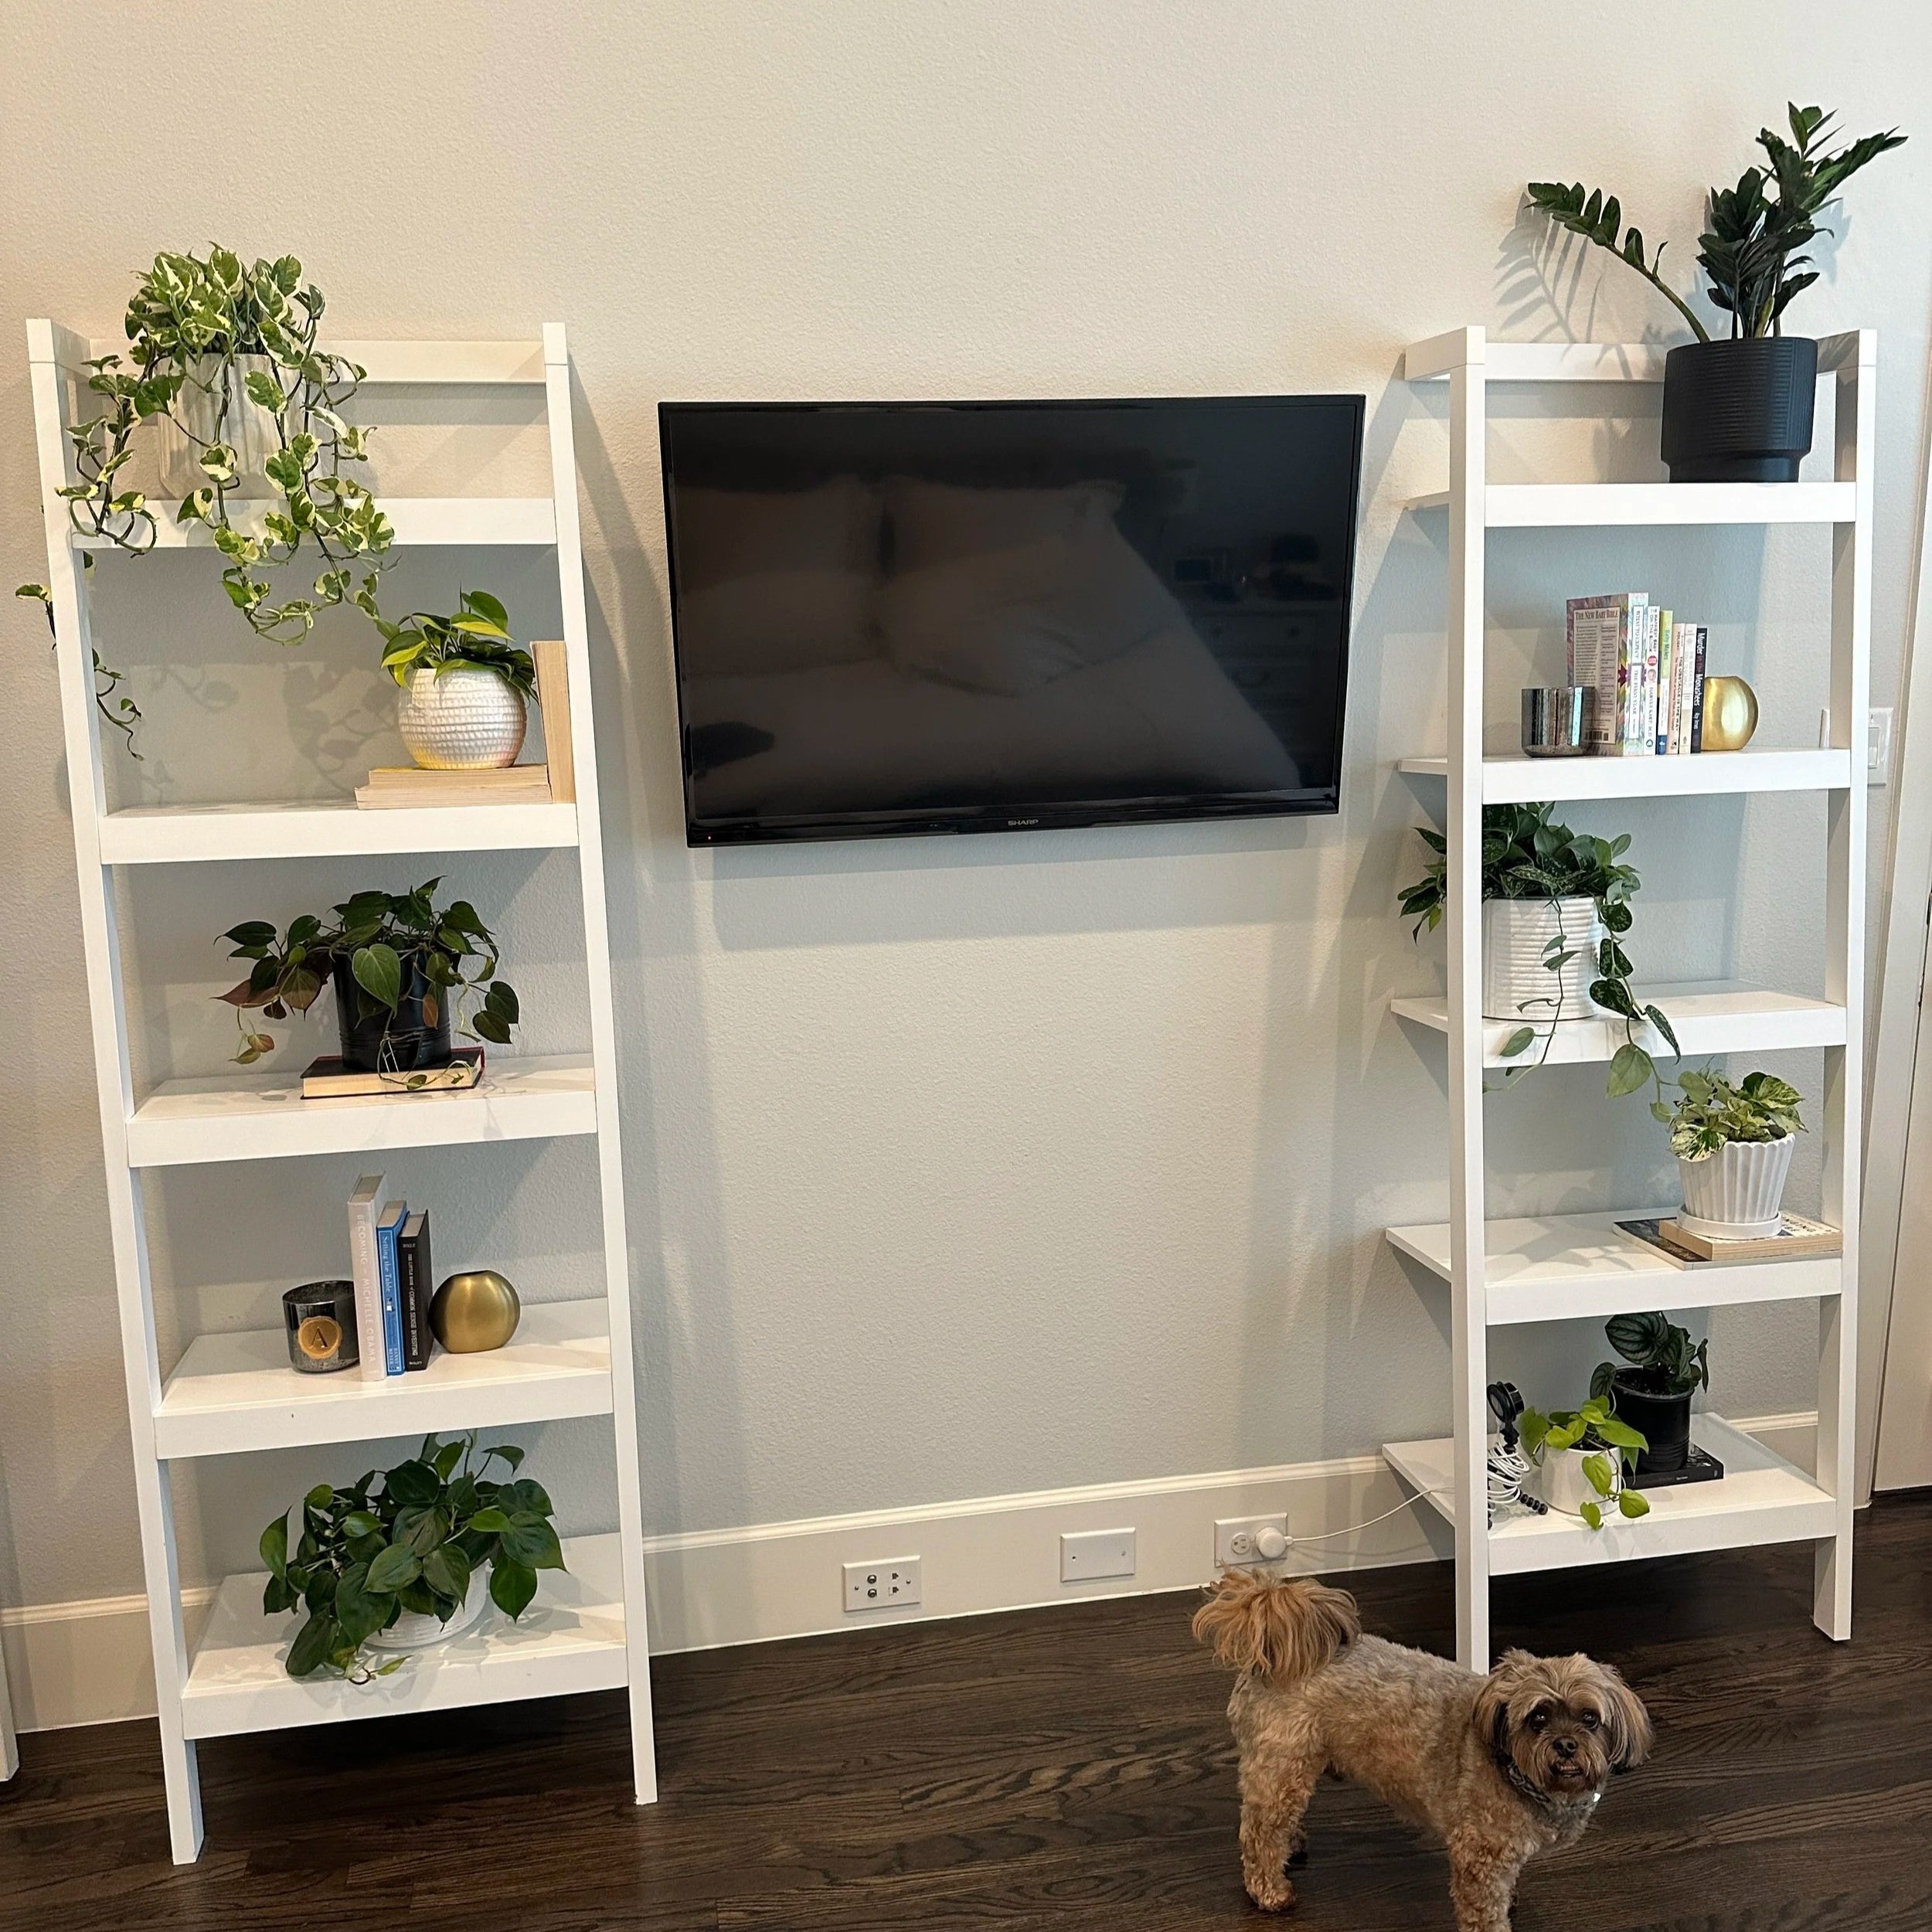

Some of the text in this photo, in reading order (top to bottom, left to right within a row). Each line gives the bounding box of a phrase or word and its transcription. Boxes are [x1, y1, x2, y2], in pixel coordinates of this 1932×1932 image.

[1585, 611, 1595, 619] NEW
[1607, 609, 1618, 617] BIBLE
[1696, 632, 1706, 655] Murder
[1696, 663, 1704, 673] the
[1694, 673, 1703, 706] Monashees
[357, 1214, 377, 1363] BECOMING MICHELLE OBAMA
[308, 1326, 328, 1349] A
